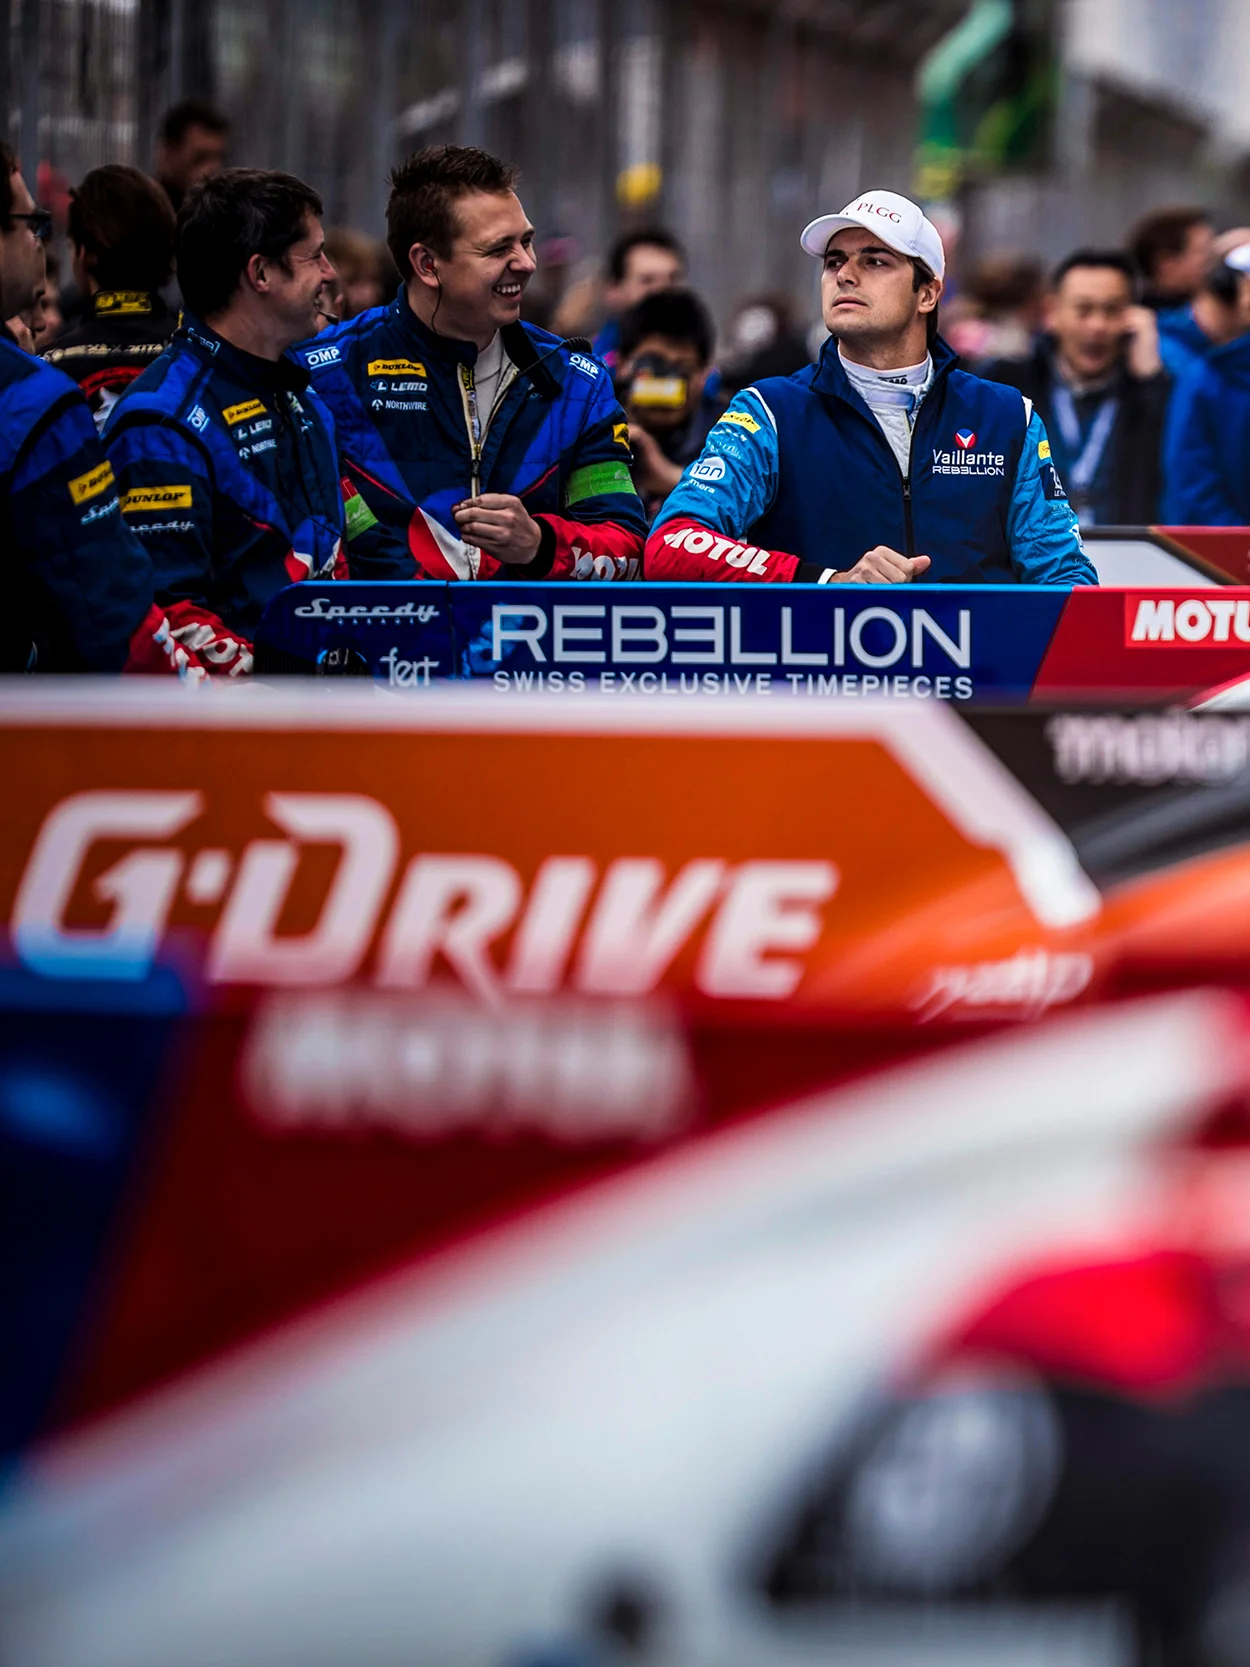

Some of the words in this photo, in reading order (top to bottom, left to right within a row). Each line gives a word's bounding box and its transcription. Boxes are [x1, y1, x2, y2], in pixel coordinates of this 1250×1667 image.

[857, 202, 902, 224] PLGG
[308, 348, 340, 366] OMP
[570, 354, 599, 376] OMP
[390, 382, 428, 392] LEMO
[385, 400, 428, 412] NORTHWIRE
[932, 448, 1005, 467] Vaillante
[932, 465, 1005, 477] REBELLION
[663, 528, 772, 577] MOTUL
[294, 598, 440, 623] Speedy
[491, 604, 972, 669] REBELLION
[379, 646, 441, 687] fert
[492, 670, 586, 694] SWISS
[600, 671, 773, 696] EXCLUSIVE
[786, 672, 974, 701] TIMEPIECES
